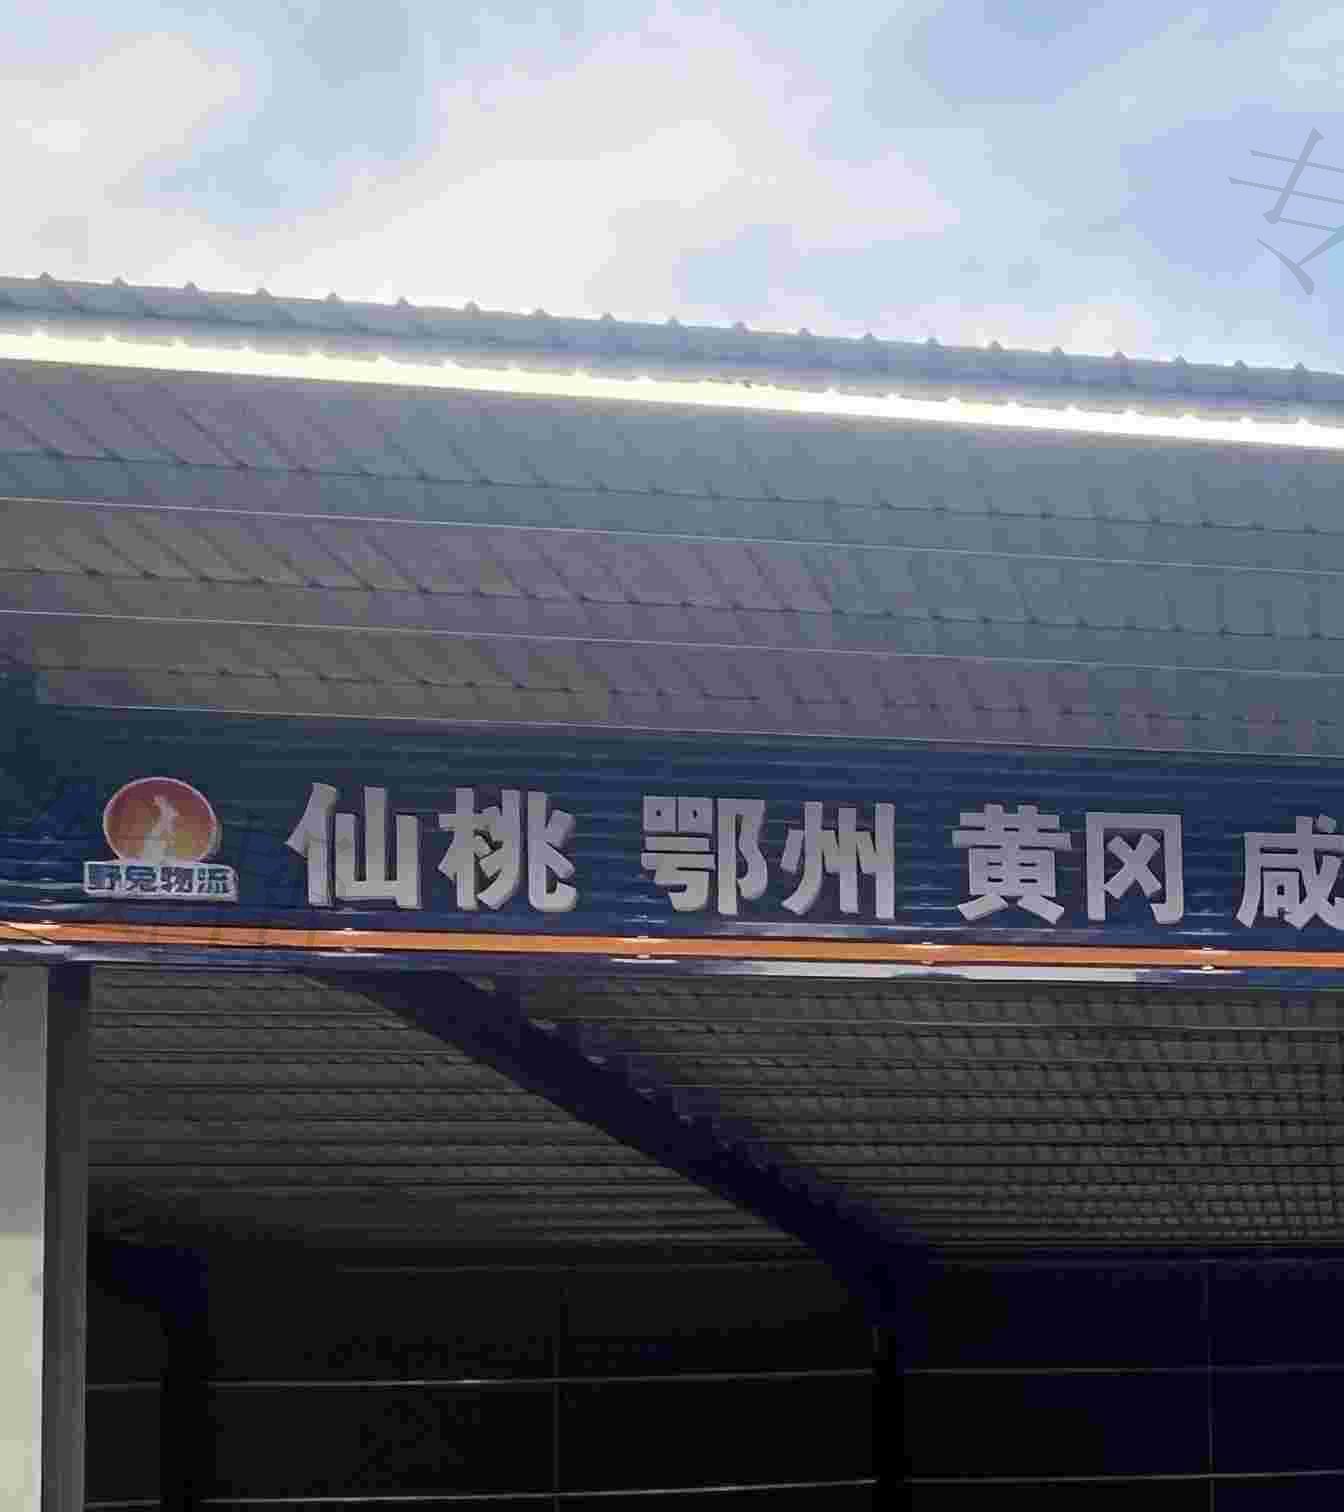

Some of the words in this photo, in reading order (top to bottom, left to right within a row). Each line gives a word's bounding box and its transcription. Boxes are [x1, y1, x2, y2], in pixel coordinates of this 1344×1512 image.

[286, 783, 577, 911] 仙桃
[641, 796, 895, 920] 鄂州
[952, 804, 1185, 924] 黄冈
